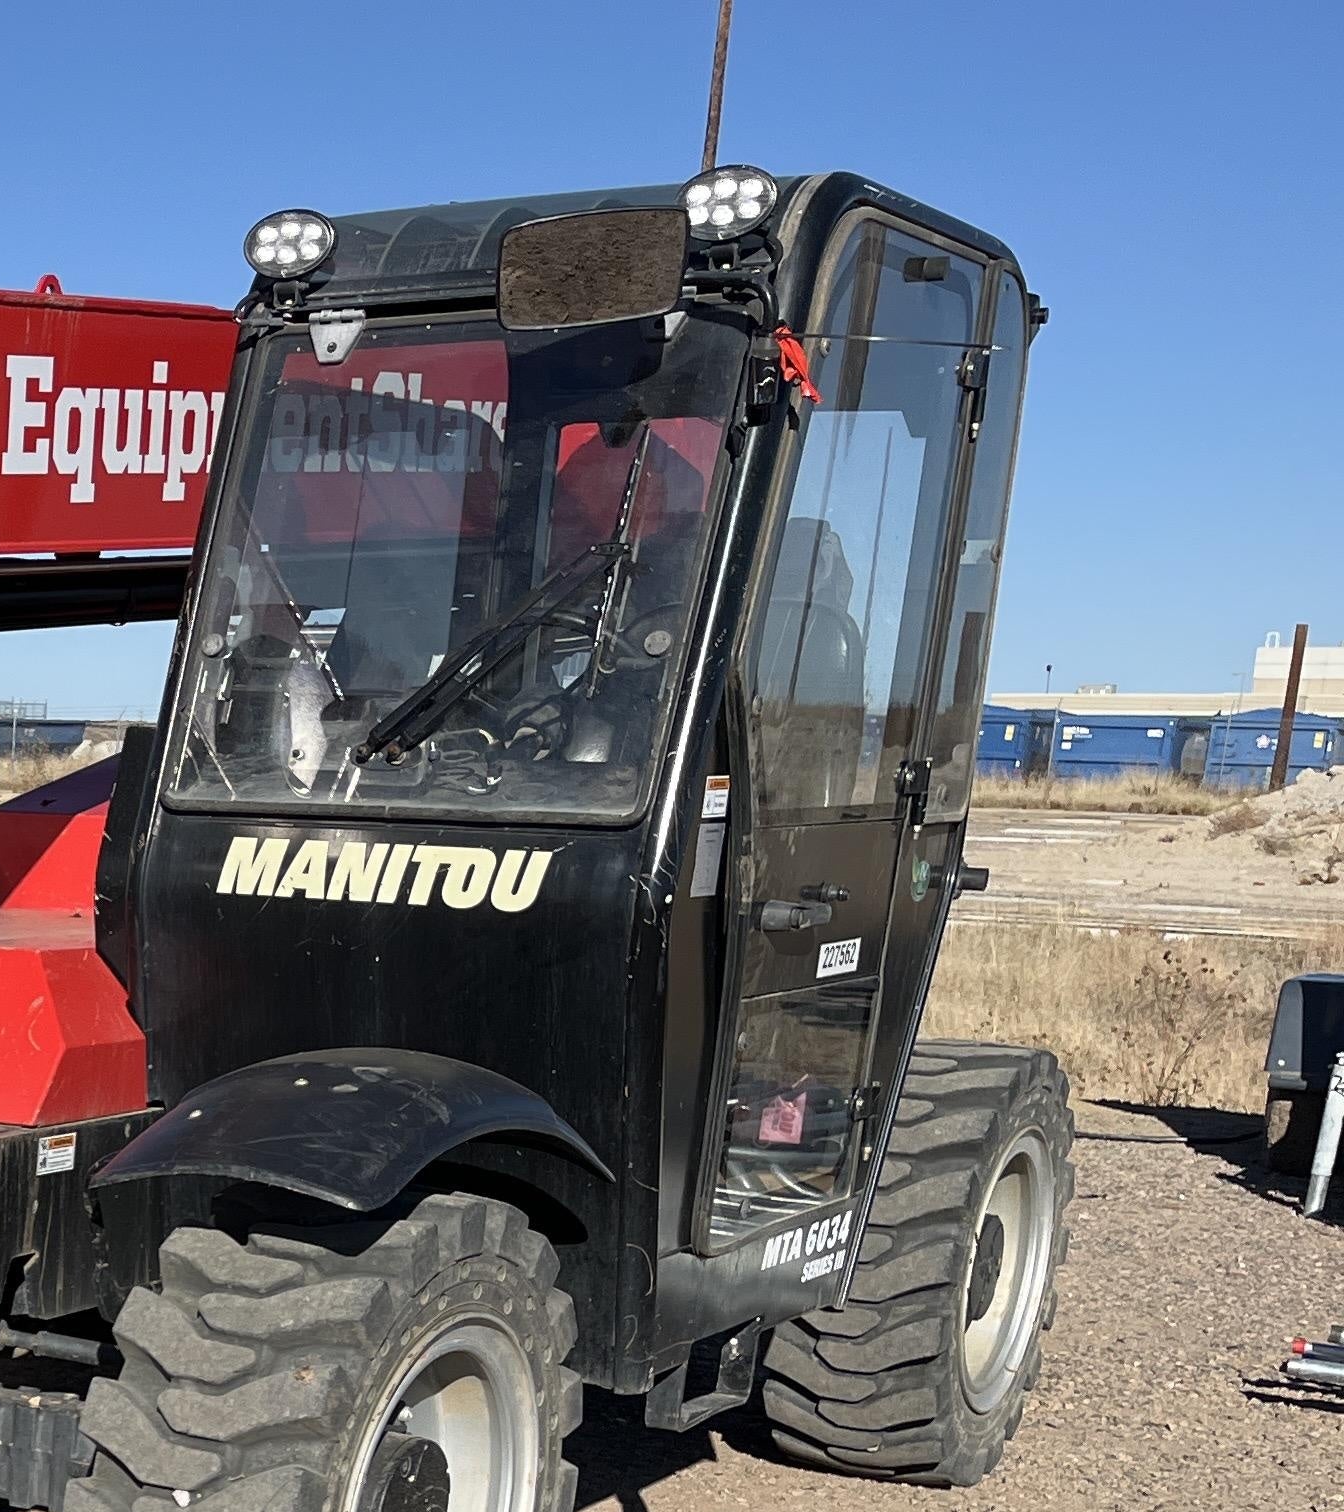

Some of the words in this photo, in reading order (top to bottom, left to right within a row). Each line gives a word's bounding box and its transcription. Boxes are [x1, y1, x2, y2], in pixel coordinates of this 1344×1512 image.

[216, 836, 554, 913] MANITOU
[822, 942, 857, 969] 227562
[760, 1227, 804, 1271] MTA
[805, 1210, 853, 1256] 6034
[800, 1252, 835, 1284] SERIES
